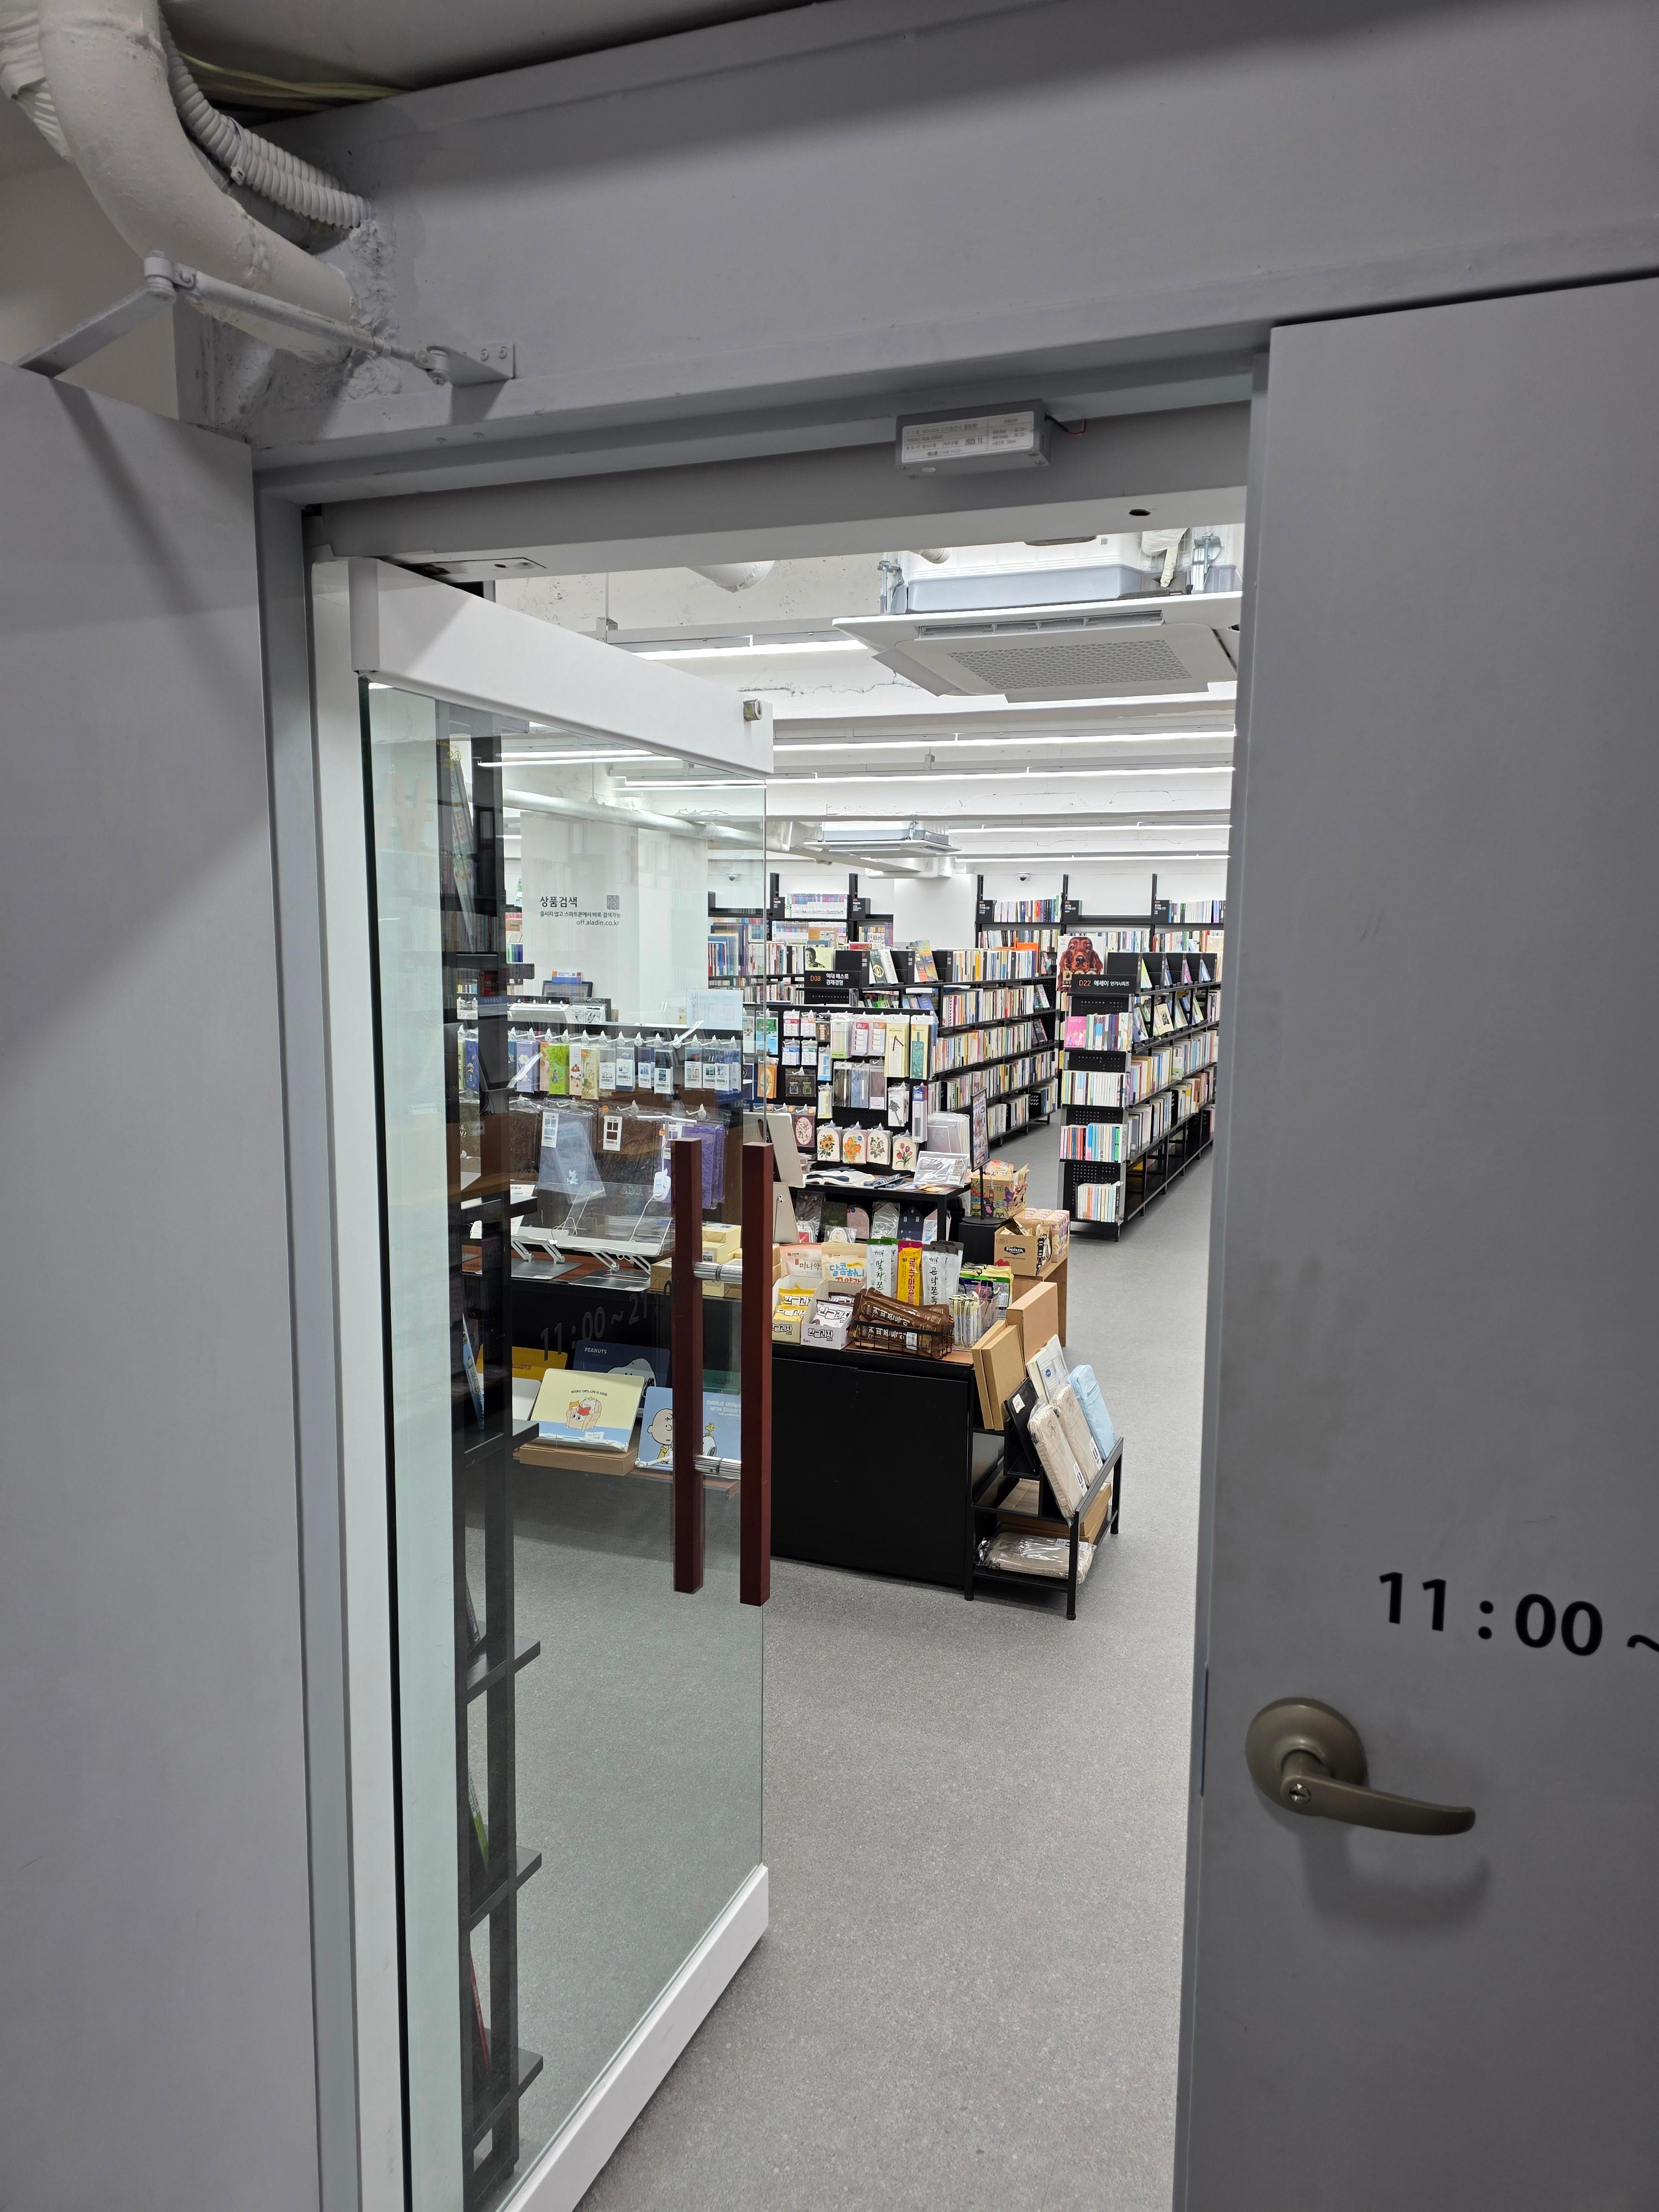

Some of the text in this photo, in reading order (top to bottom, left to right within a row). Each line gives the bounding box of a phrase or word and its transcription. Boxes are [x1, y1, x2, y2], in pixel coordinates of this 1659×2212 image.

[540, 896, 577, 907] 상품검색
[799, 1261, 822, 1271] 미니약
[772, 1323, 792, 1334] 글과자
[1379, 1571, 1603, 1656] 11:00
